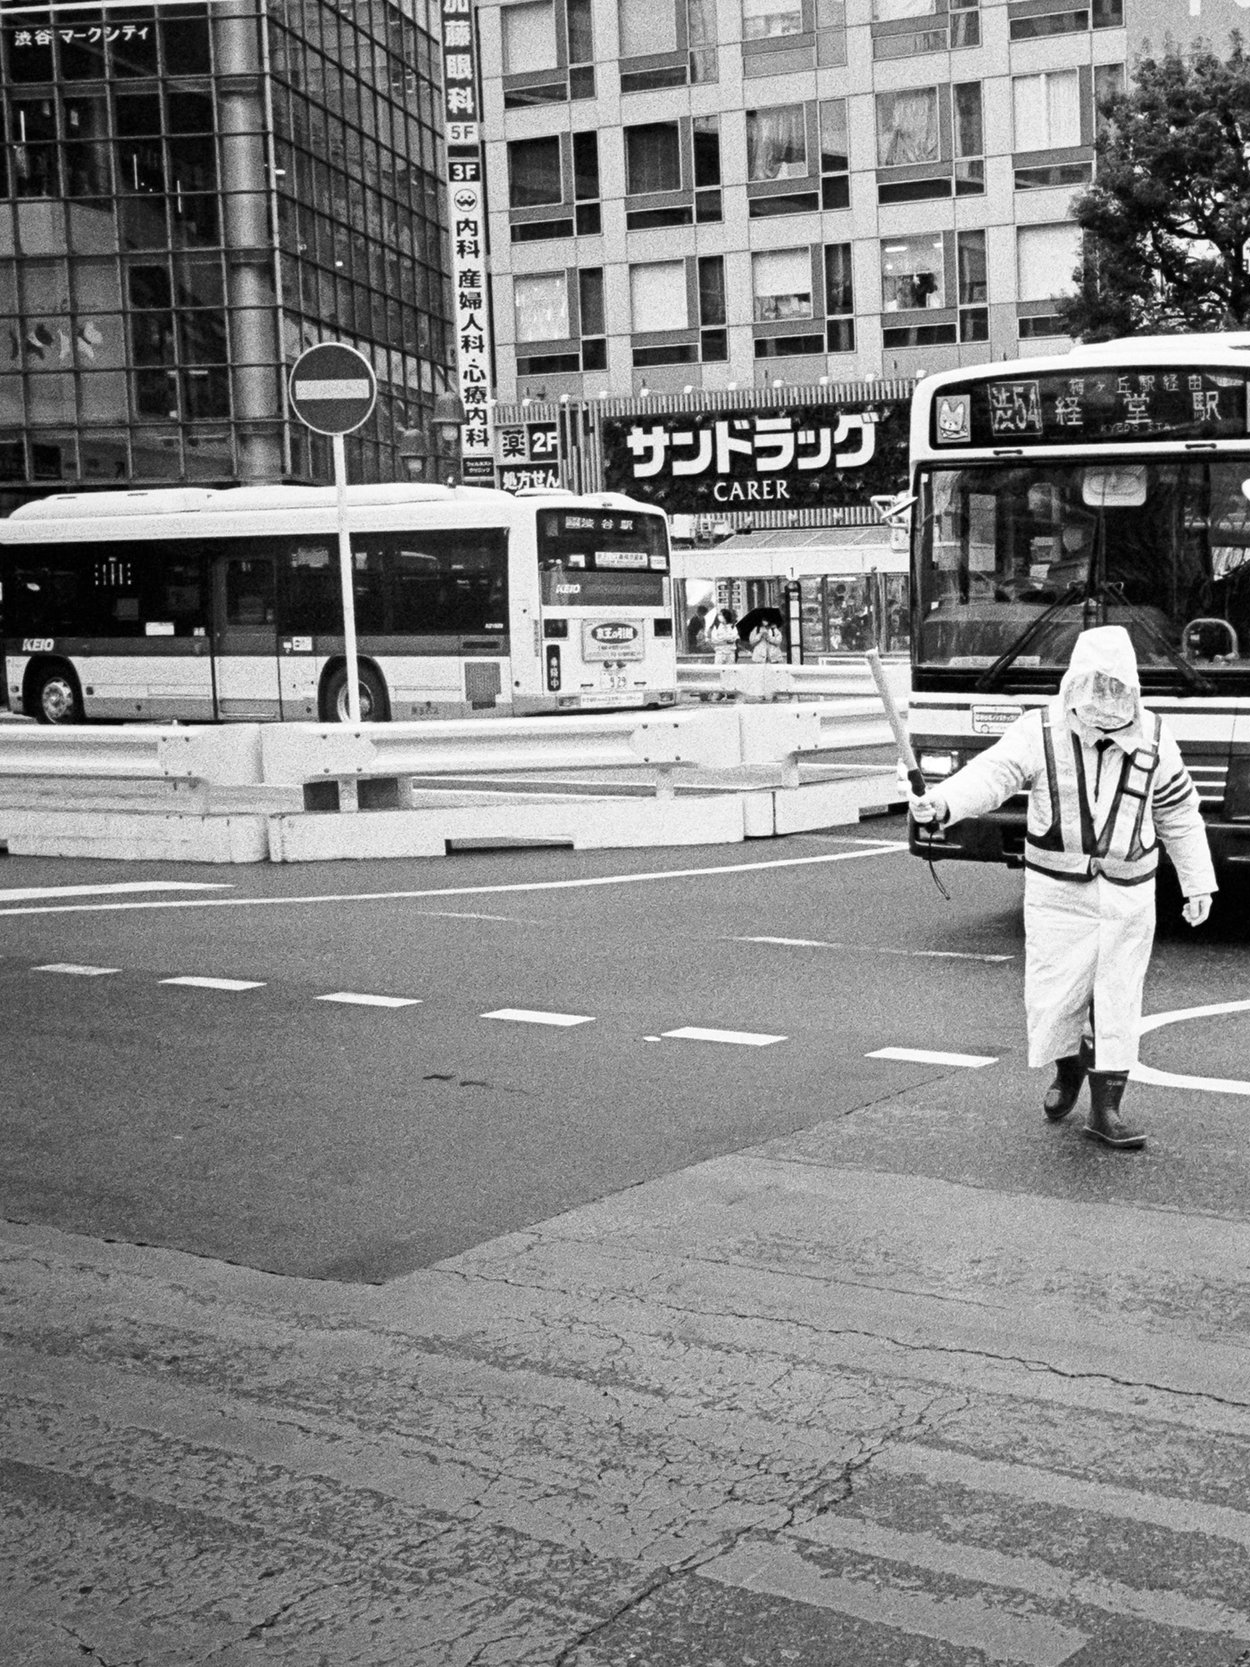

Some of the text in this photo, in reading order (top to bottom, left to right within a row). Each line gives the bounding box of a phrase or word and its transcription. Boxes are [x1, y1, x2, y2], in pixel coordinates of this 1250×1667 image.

[451, 125, 474, 139] 5F
[453, 164, 476, 180] 3F
[456, 218, 480, 259] 内科
[502, 429, 526, 458] 薬
[532, 431, 558, 453] 2F
[626, 411, 881, 478] サンドラッグ
[502, 469, 560, 490] 処方せん
[714, 480, 790, 501] CARER
[556, 583, 580, 594] KEIO
[22, 638, 55, 651] KEIO
